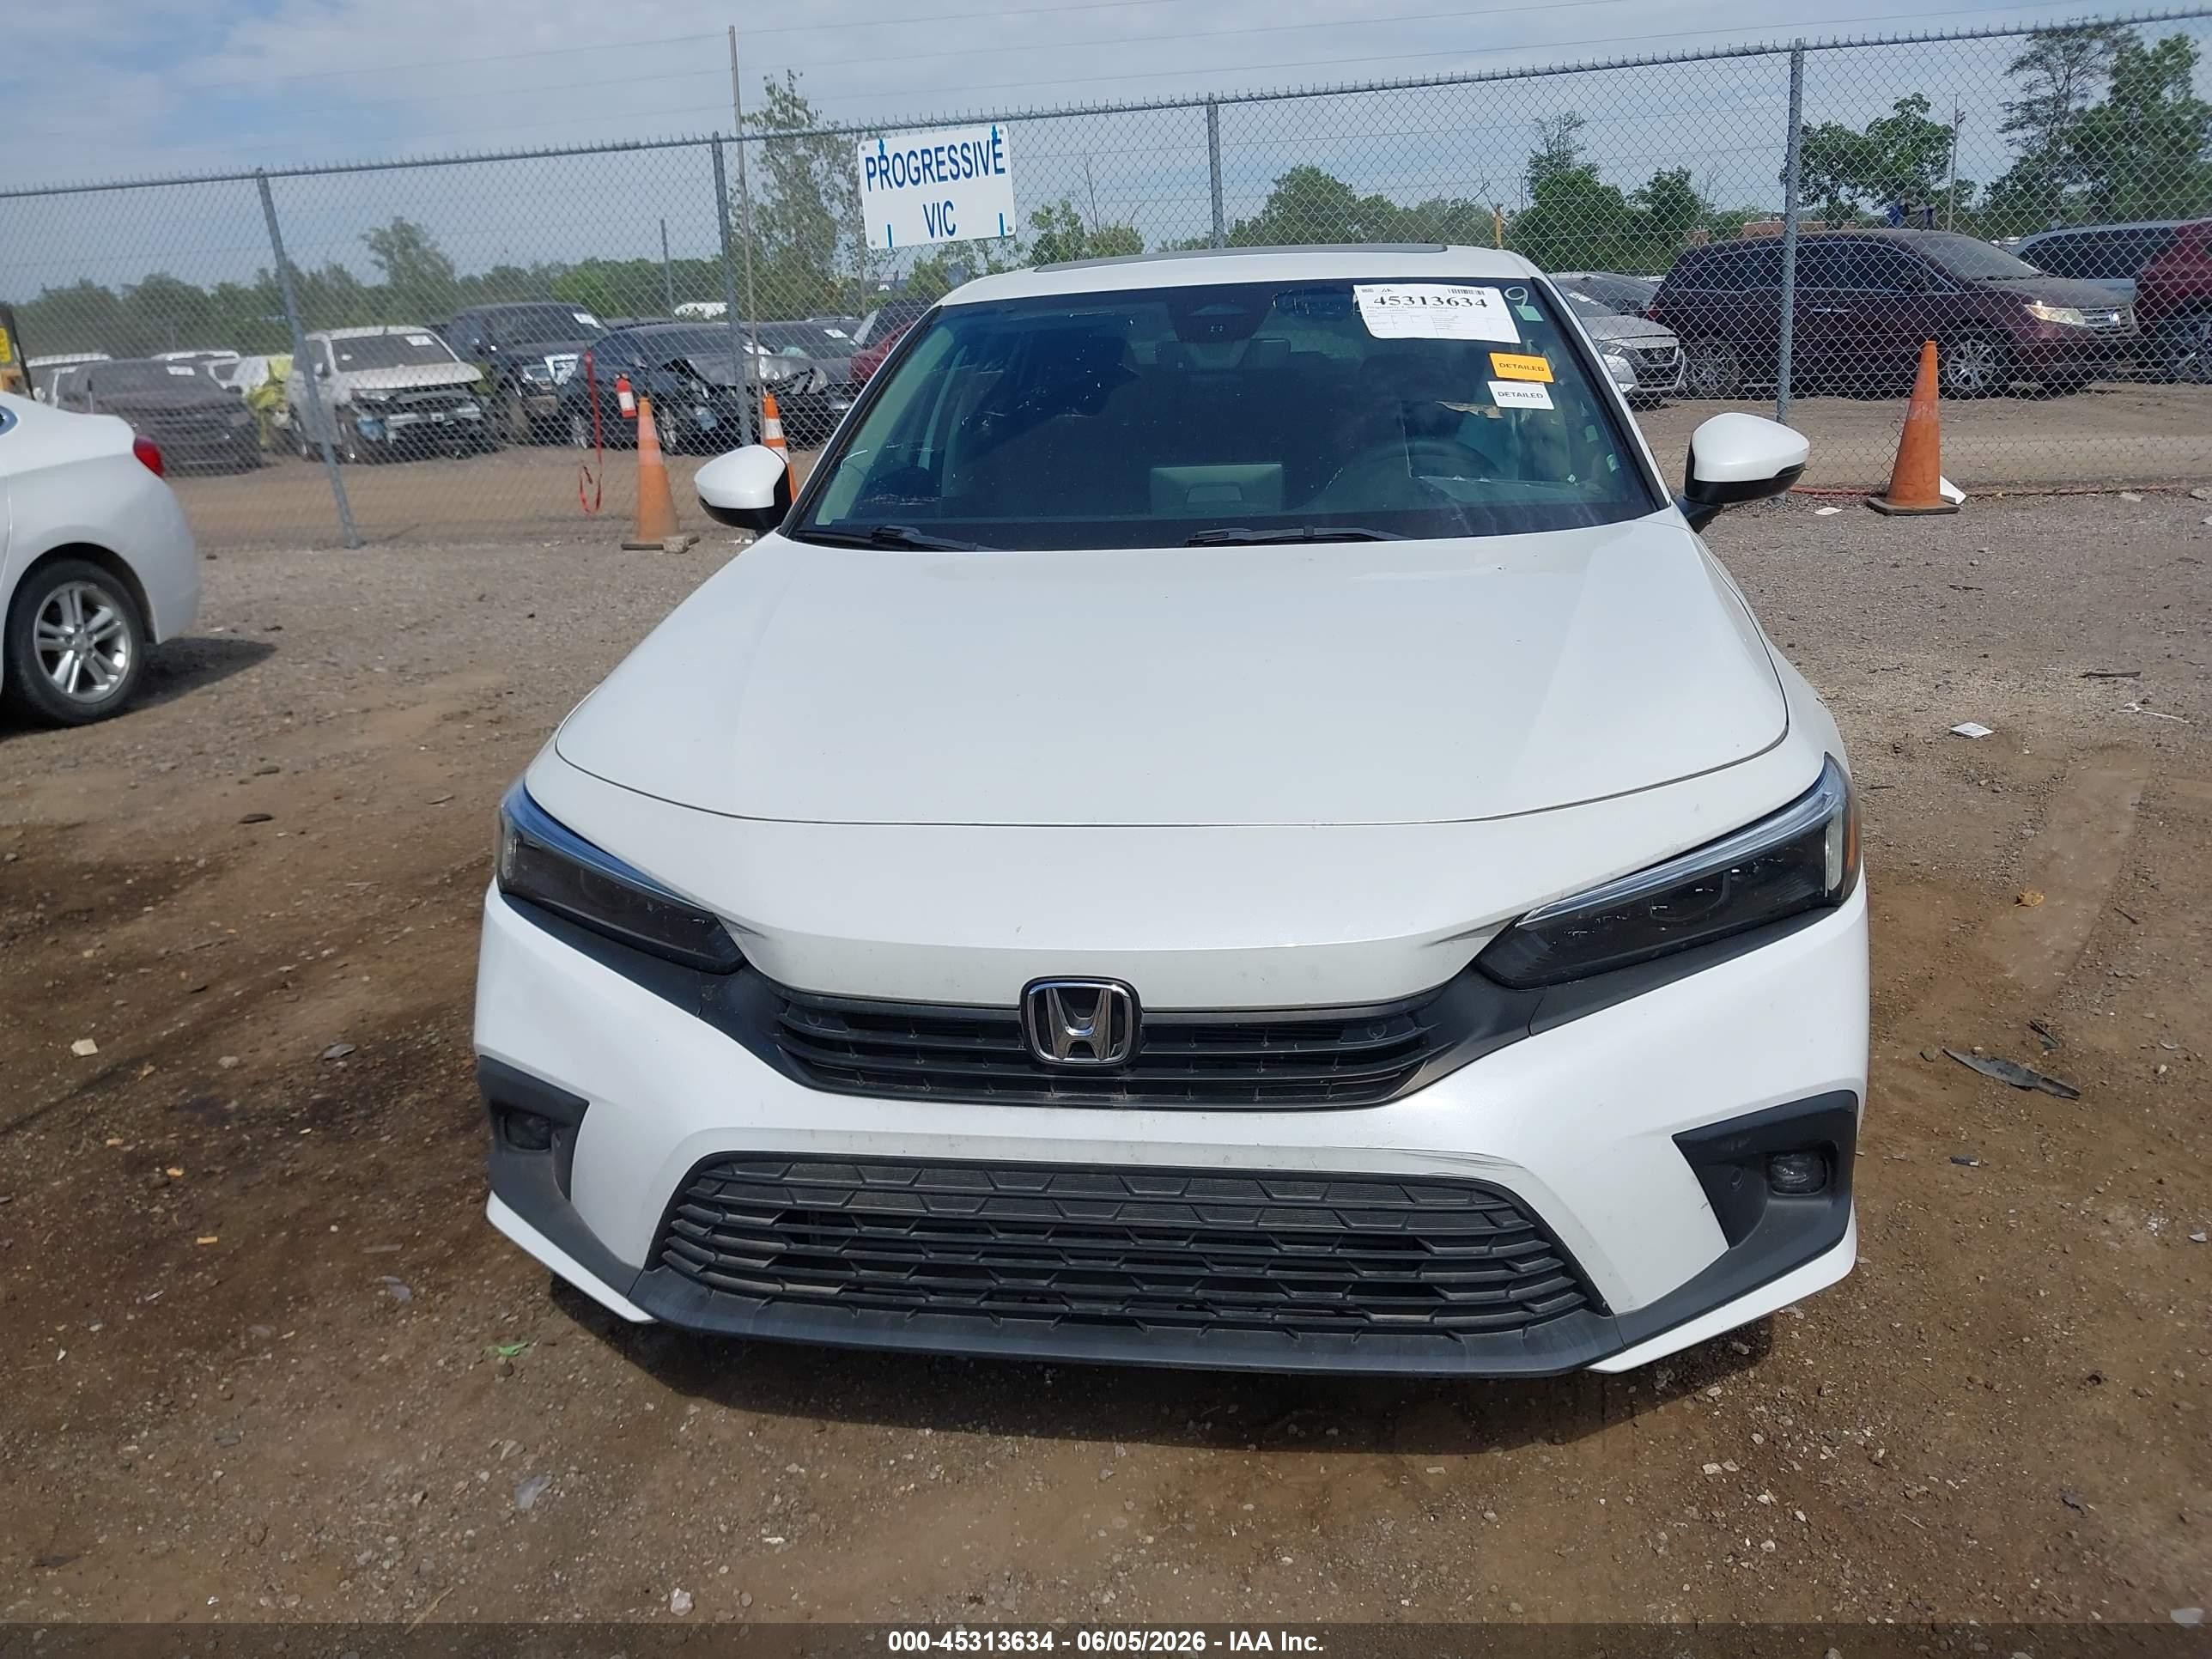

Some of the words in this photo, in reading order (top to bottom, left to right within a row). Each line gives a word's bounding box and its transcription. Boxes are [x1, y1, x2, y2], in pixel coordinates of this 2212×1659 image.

[866, 138, 1006, 191] PROGRESSIVE
[923, 200, 957, 239] VIC
[1374, 295, 1489, 307] 45313634
[1498, 362, 1545, 372] DETAILED
